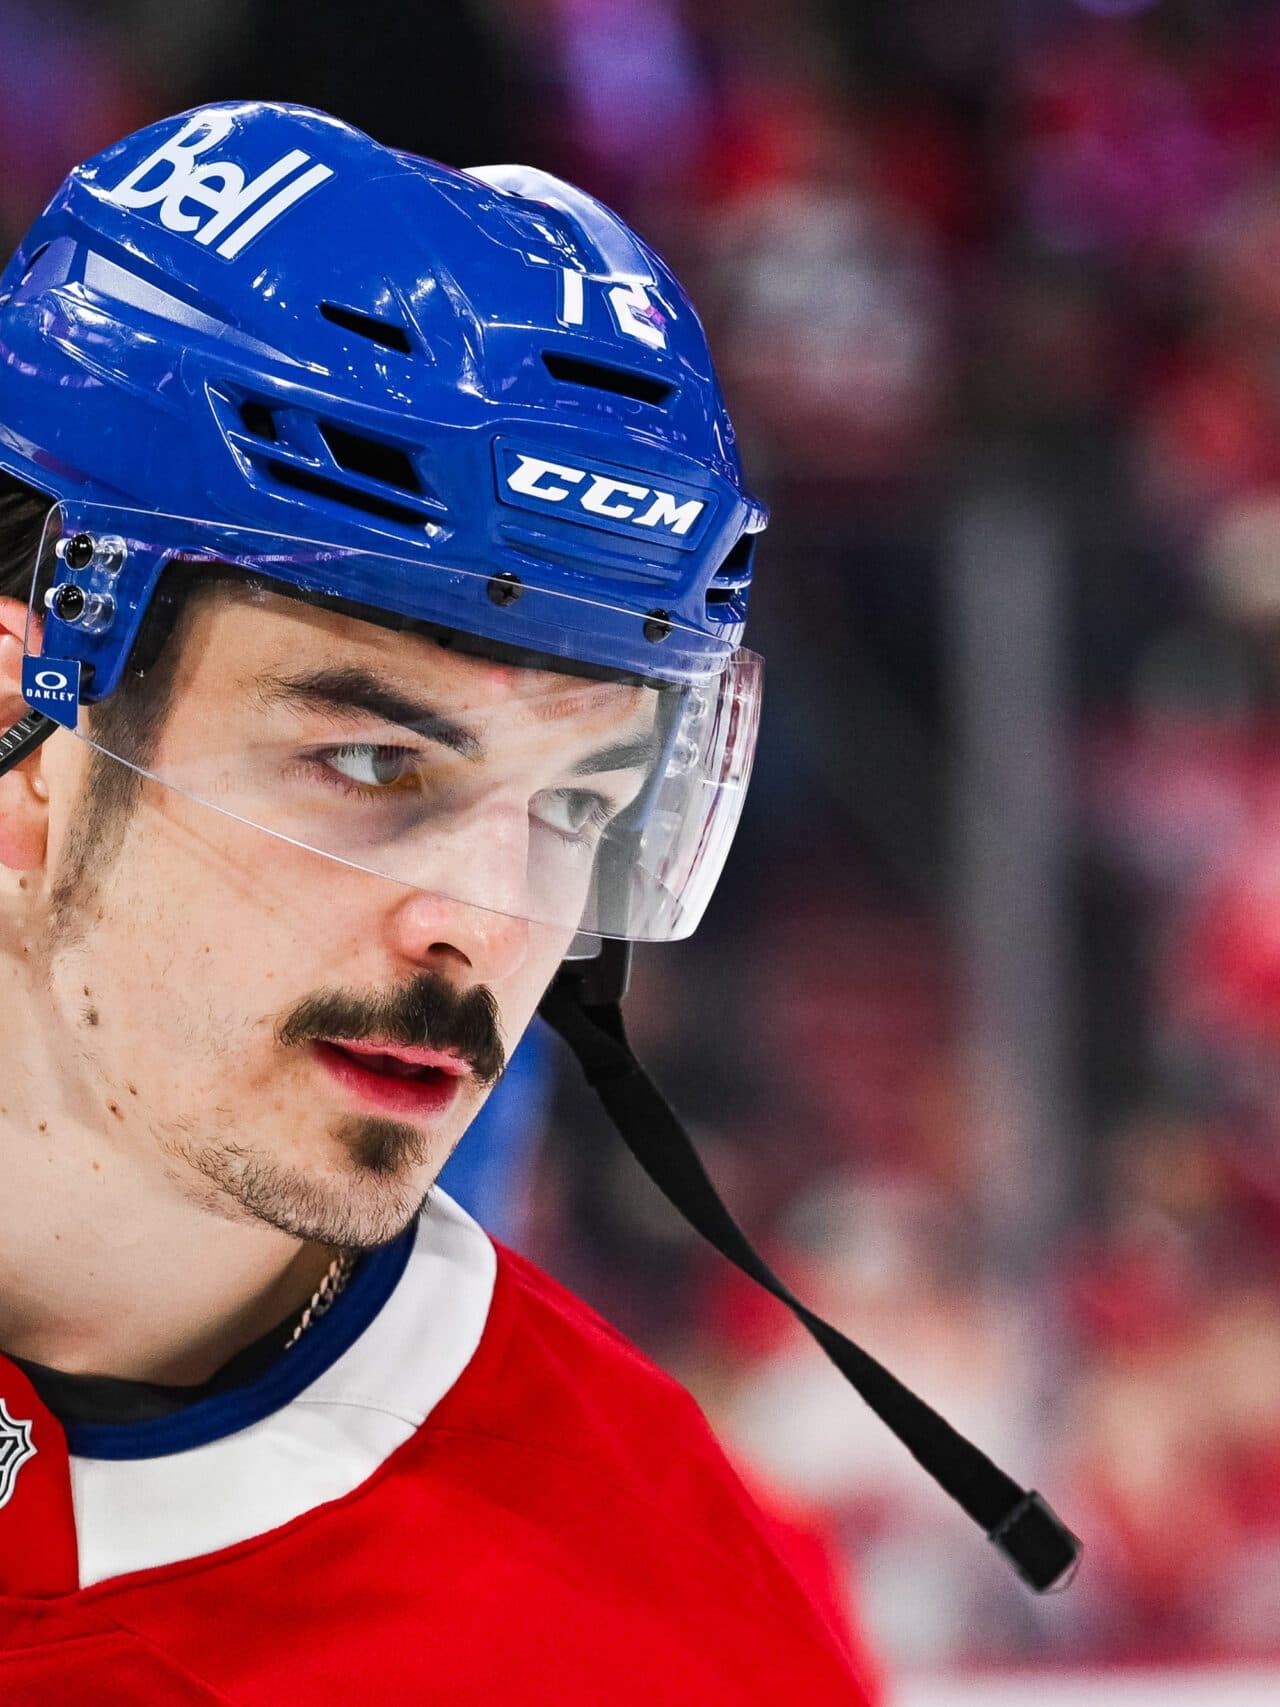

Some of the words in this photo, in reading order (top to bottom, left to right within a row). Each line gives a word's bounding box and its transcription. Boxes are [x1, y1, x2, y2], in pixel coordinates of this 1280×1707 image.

[111, 109, 333, 259] Bell
[507, 454, 704, 535] CCM
[26, 688, 75, 702] OAKLEY
